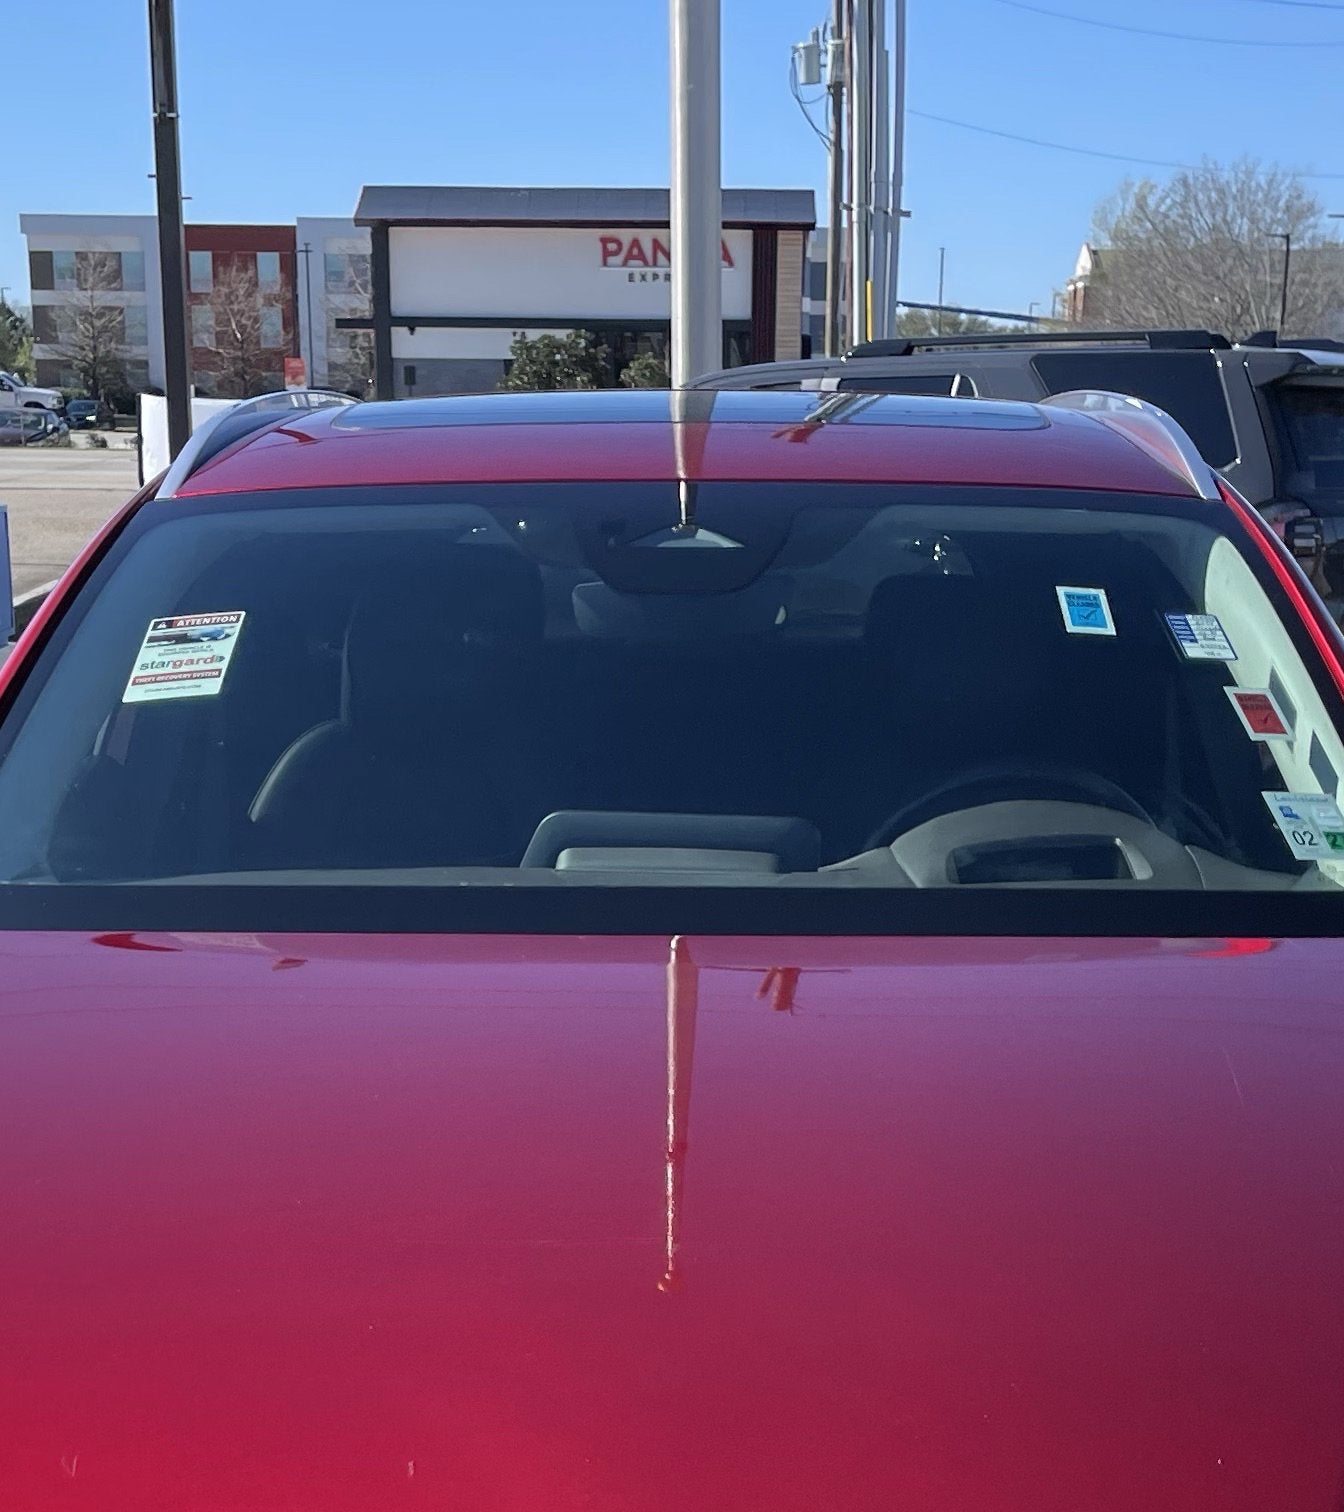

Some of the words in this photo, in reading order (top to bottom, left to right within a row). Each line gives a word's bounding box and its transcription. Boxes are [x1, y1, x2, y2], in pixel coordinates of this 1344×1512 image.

[599, 236, 735, 267] PANA
[176, 615, 238, 627] ATTENTION
[1291, 830, 1320, 846] 02
